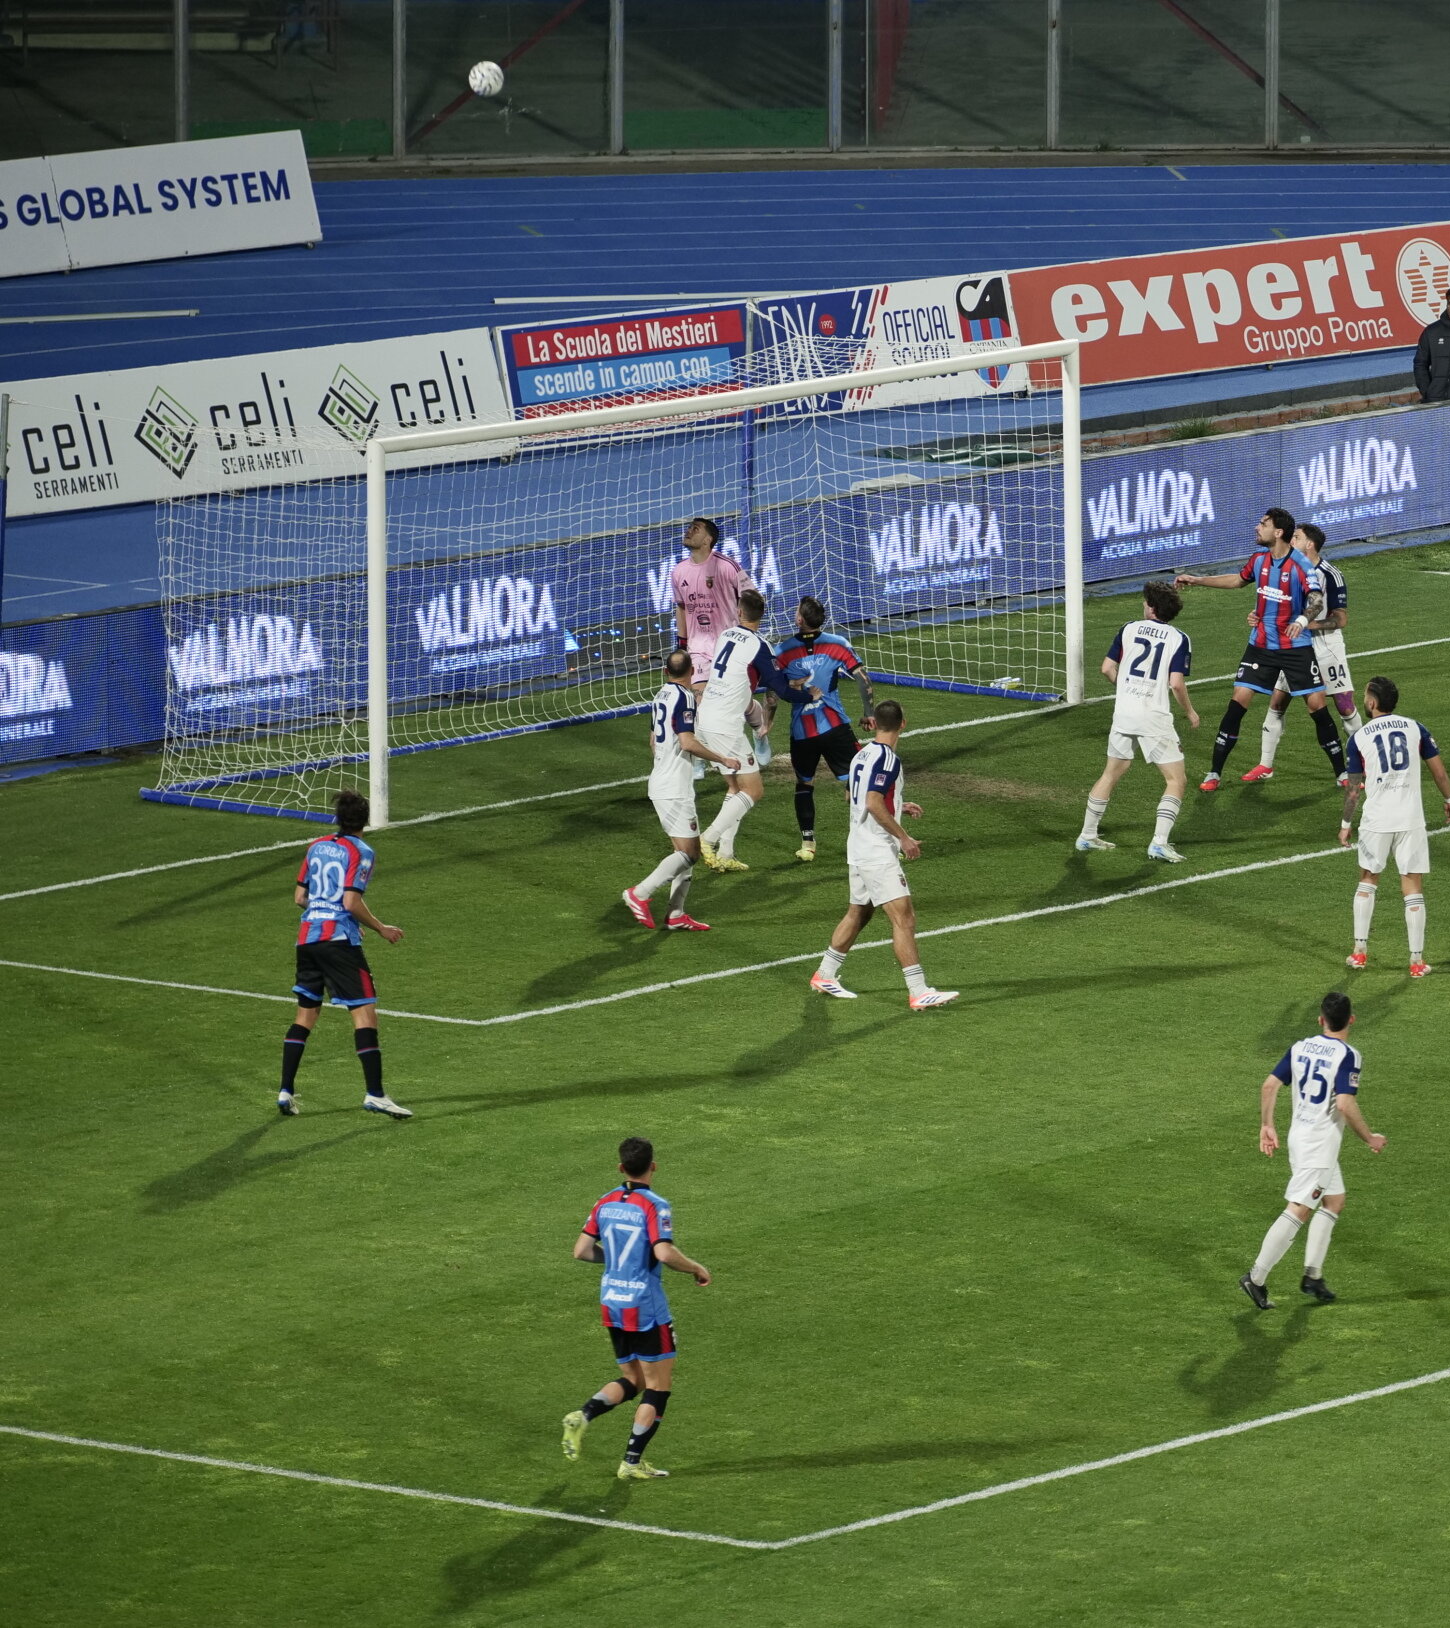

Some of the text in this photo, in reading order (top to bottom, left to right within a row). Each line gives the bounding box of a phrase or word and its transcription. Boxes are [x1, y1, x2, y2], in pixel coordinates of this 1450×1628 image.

[16, 183, 152, 227] GLOBAL
[157, 169, 291, 212] SYSTEM
[1050, 241, 1385, 345] expert
[527, 316, 718, 364] La Scuola dei Mestieri
[820, 320, 834, 329] 1992
[883, 305, 955, 345] OFFICIAL
[1243, 316, 1393, 356] Gruppo Poma
[390, 350, 477, 428] celi
[534, 355, 711, 397] scende in campo con
[210, 372, 297, 451] celi
[22, 394, 114, 475] celi
[222, 449, 304, 475] SERRAMENTI
[1298, 437, 1417, 508] VALMORA
[34, 472, 119, 499] SERRAMENTI
[1087, 468, 1215, 540] VALMORA
[1311, 498, 1404, 526] ACQUA MINERALE
[869, 501, 1003, 576] VALMORA
[1100, 530, 1200, 559] ACQUA MINERALE
[415, 575, 559, 652] VALMORA
[1137, 625, 1168, 640] GIRELLI
[169, 614, 324, 692] VALMORA
[714, 640, 737, 679] 4
[1129, 636, 1166, 680] 21
[1310, 661, 1319, 676] 6
[1328, 664, 1346, 682] 94
[1372, 730, 1409, 774] 18
[309, 857, 345, 902] 30
[603, 1223, 642, 1272] 17
